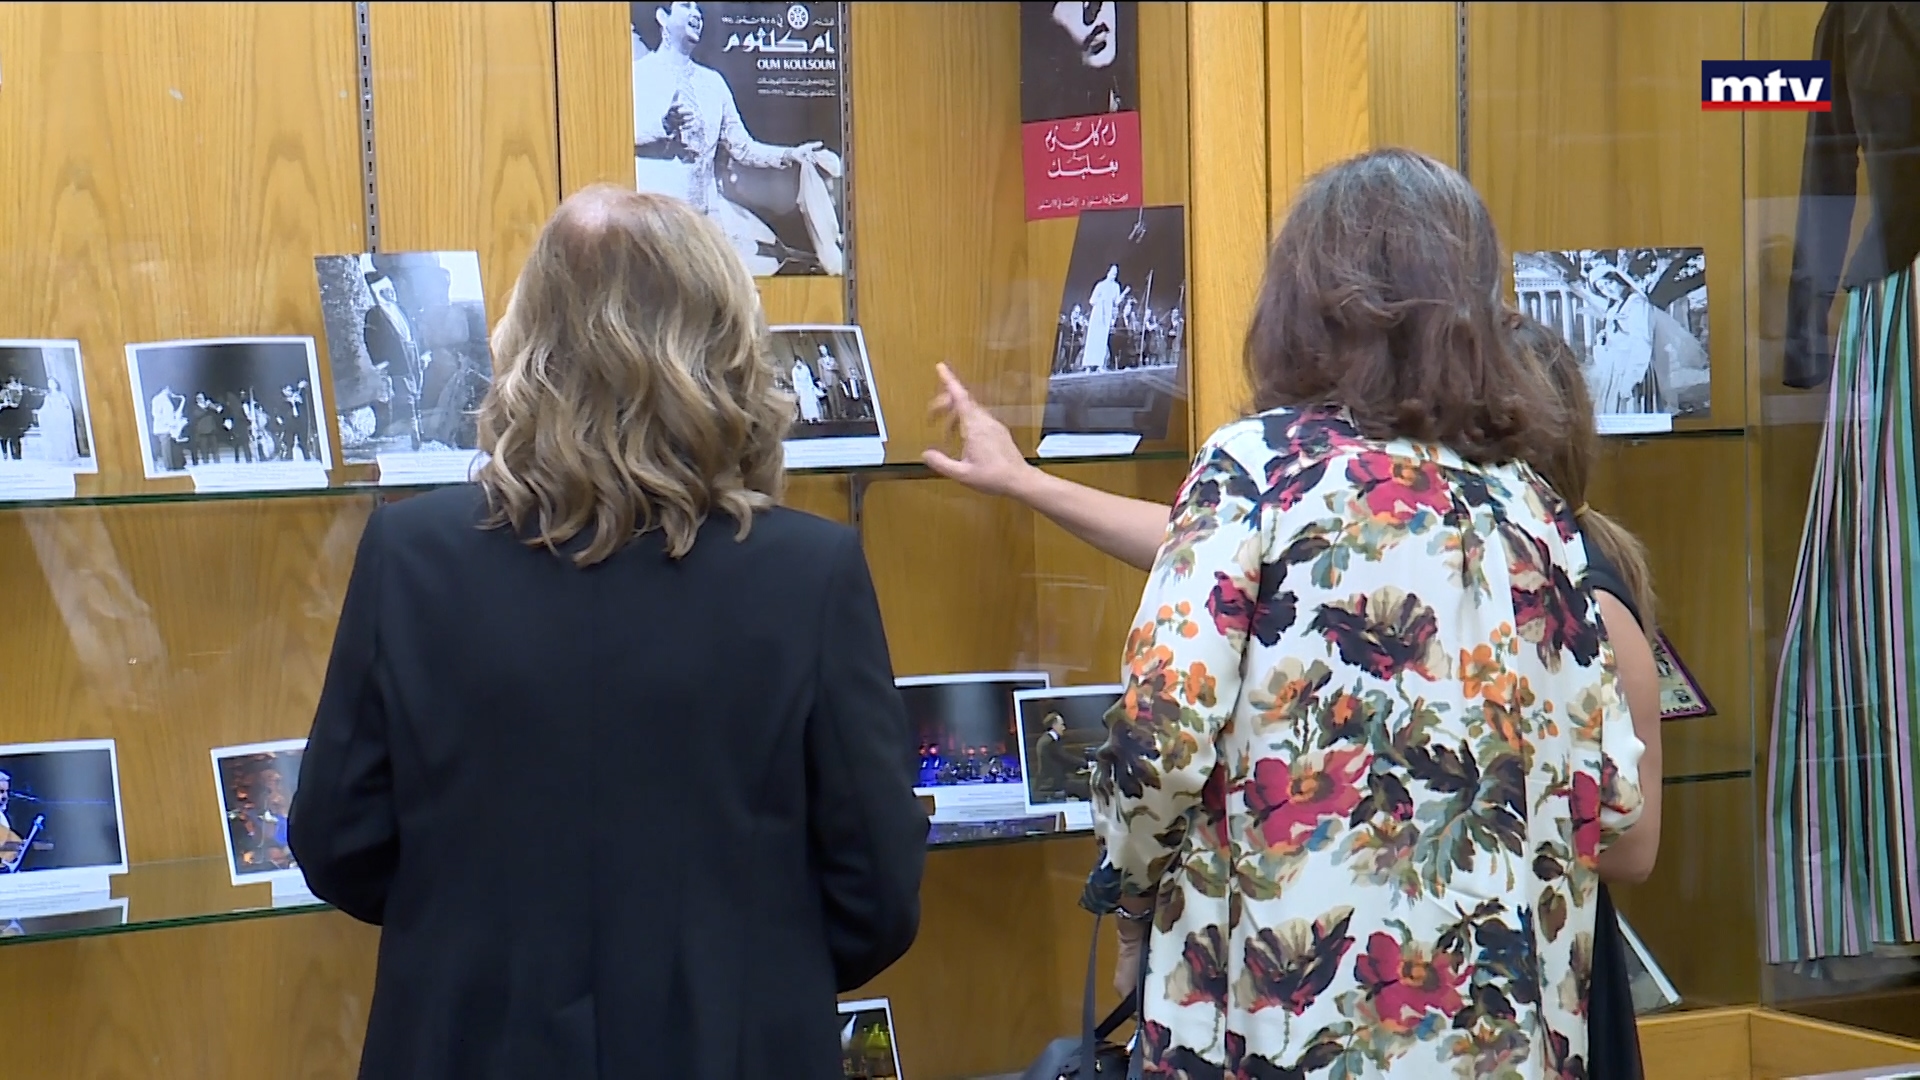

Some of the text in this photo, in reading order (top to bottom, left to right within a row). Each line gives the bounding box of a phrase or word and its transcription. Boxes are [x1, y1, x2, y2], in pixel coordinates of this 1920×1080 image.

[722, 27, 808, 53] كلثوم
[757, 59, 836, 70] OUM KOULSOUM
